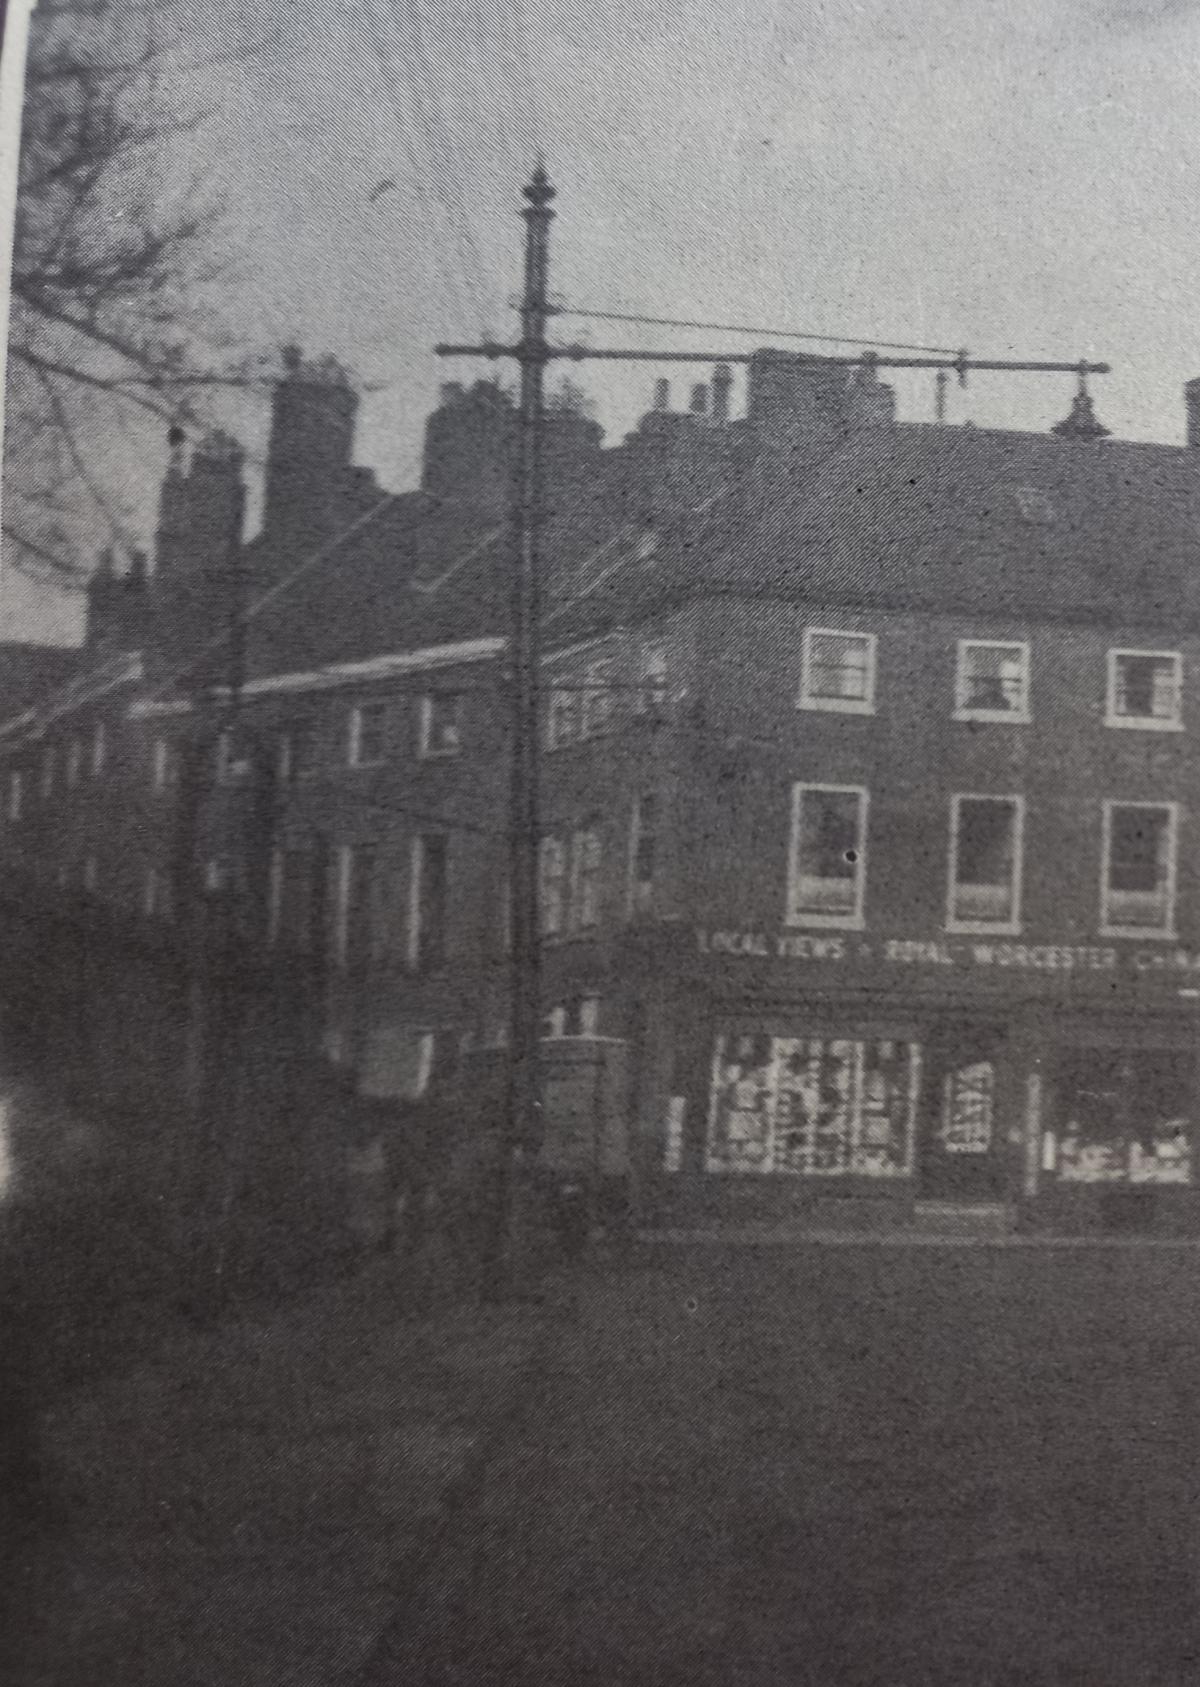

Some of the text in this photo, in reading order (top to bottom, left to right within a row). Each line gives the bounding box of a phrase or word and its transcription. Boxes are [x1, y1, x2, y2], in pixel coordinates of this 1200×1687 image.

[696, 930, 768, 956] LOCAL
[885, 939, 954, 965] ROYAL
[973, 944, 1116, 970] WORCESTER
